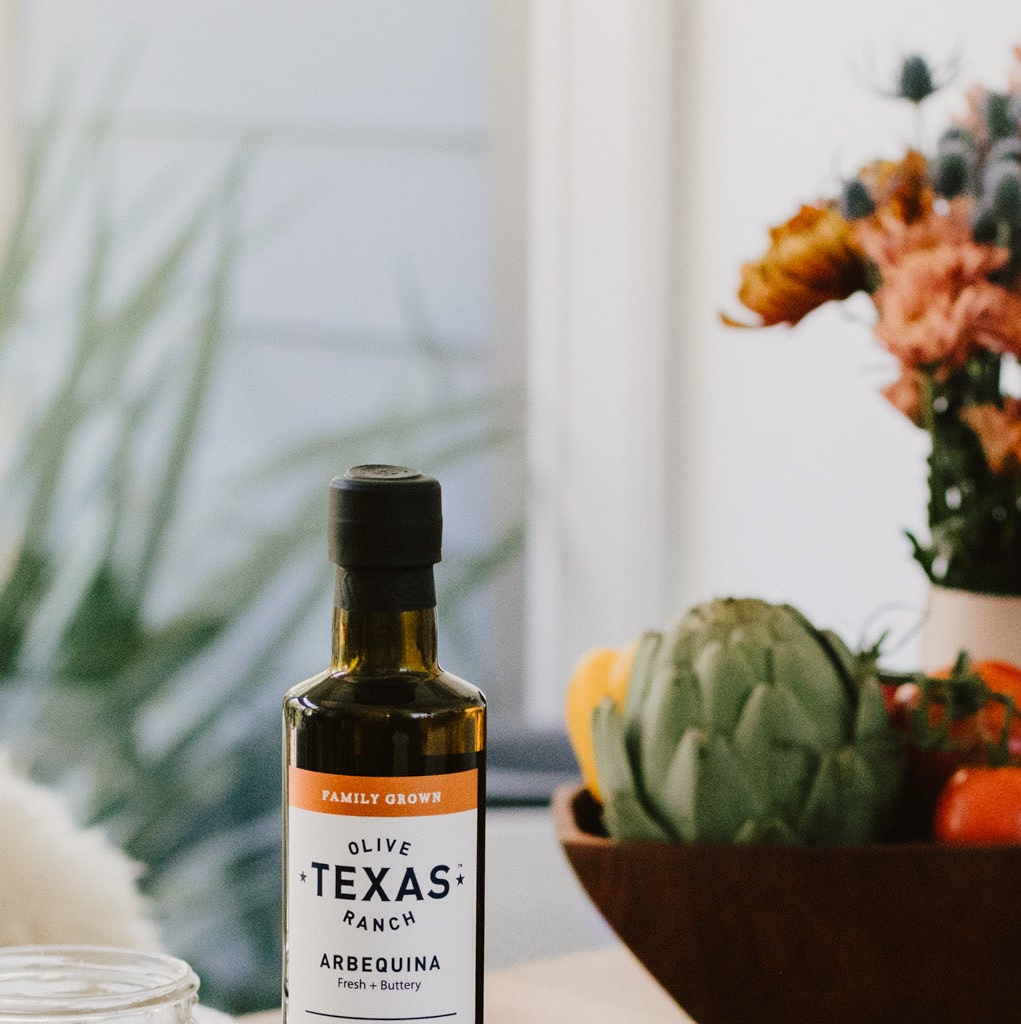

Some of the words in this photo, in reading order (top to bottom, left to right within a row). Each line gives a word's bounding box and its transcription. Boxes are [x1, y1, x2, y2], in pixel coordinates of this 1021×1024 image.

[322, 790, 379, 804] FAMILY
[385, 792, 441, 805] GROWN
[348, 838, 411, 856] OLIVE
[311, 861, 450, 902] TEXAS
[343, 910, 415, 932] RANCH
[320, 953, 440, 972] ARBEQUINA
[337, 978, 366, 990] Fresh
[380, 980, 421, 992] Buttery
